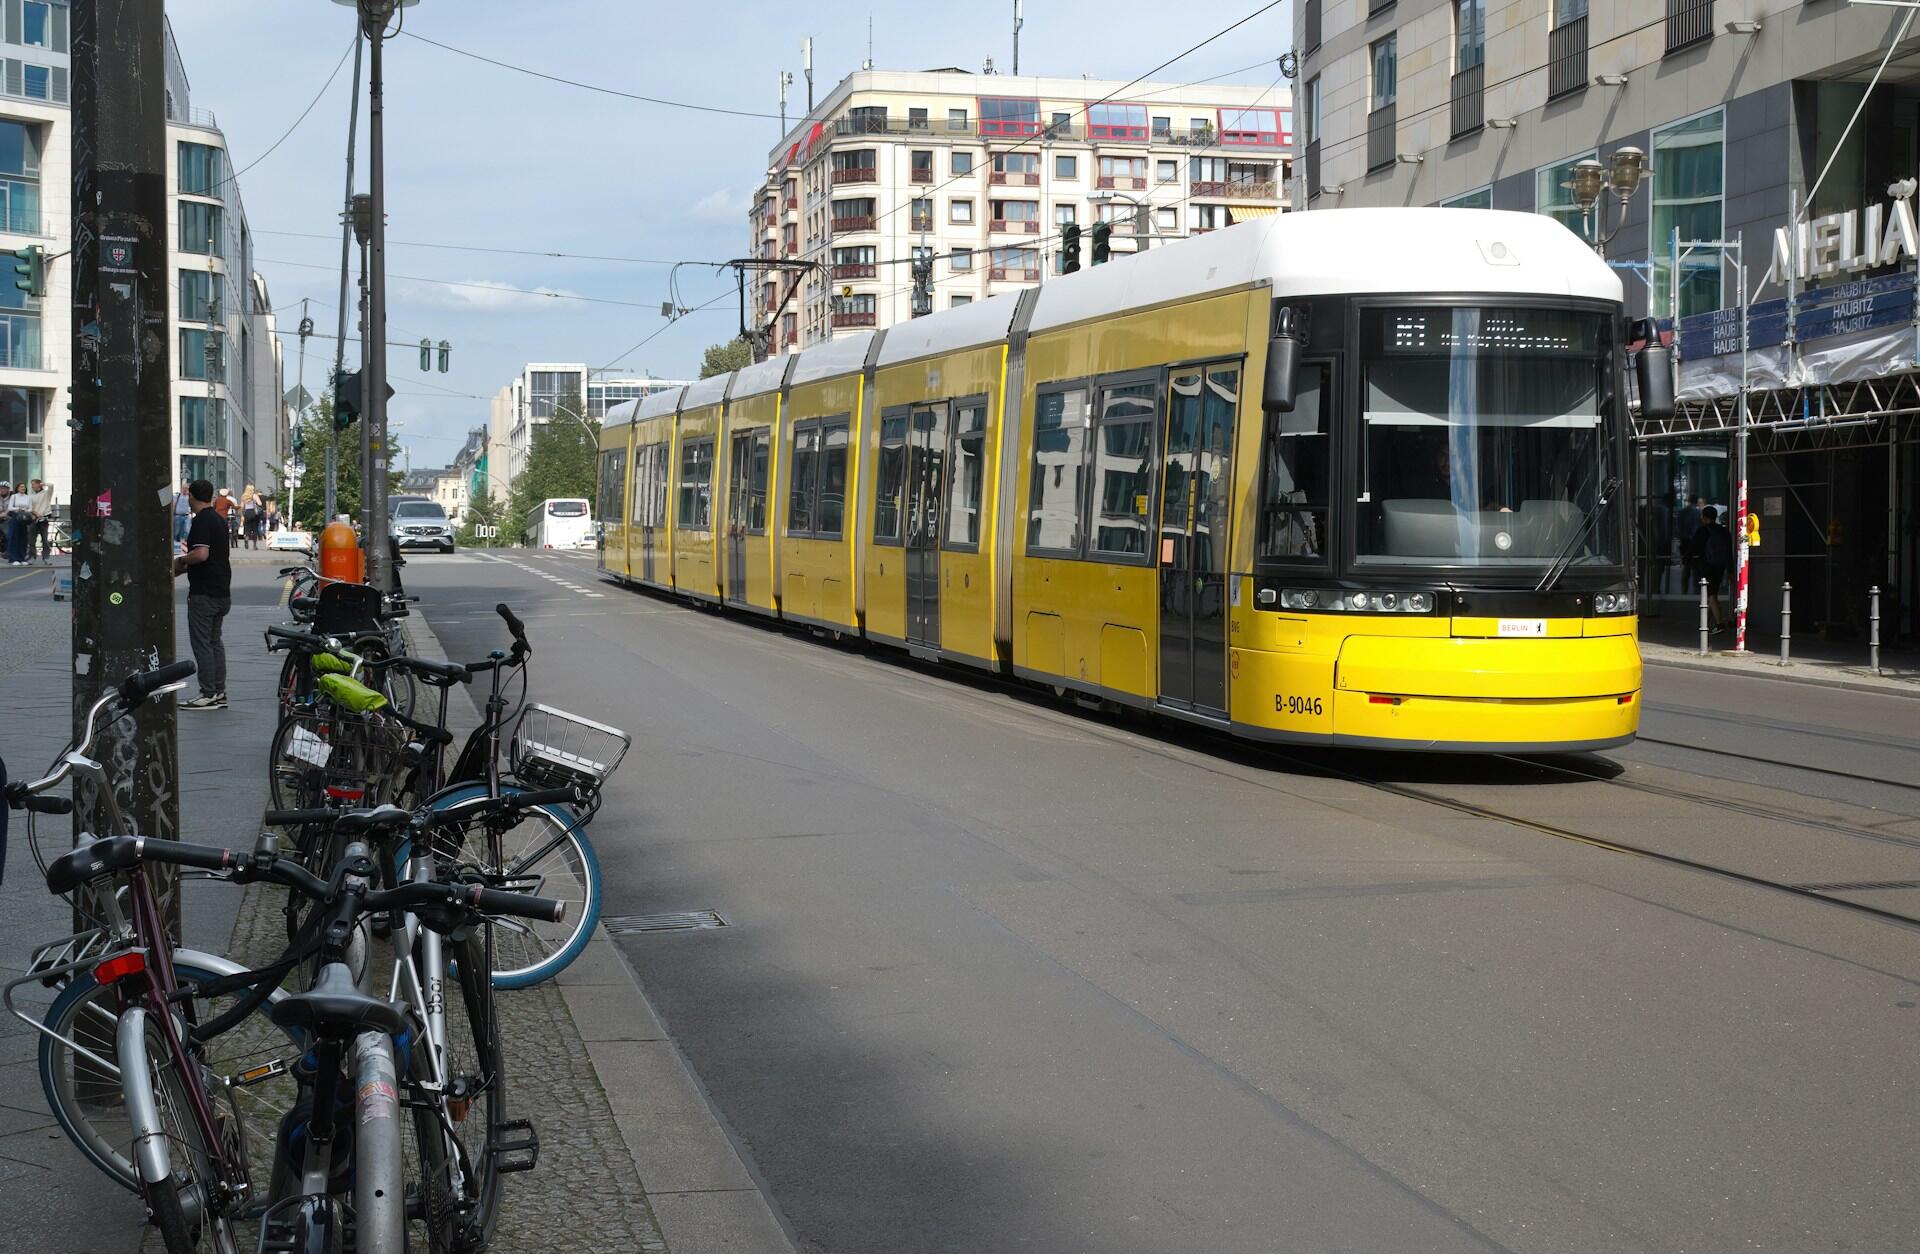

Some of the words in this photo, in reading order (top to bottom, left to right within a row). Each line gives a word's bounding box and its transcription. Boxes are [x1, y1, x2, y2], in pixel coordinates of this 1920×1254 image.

[843, 286, 852, 298] 2
[1833, 298, 1874, 319] HAUBITZ
[1502, 624, 1529, 632] BERLIN
[1275, 694, 1323, 716] B-9046
[427, 976, 443, 1016] 8bar
